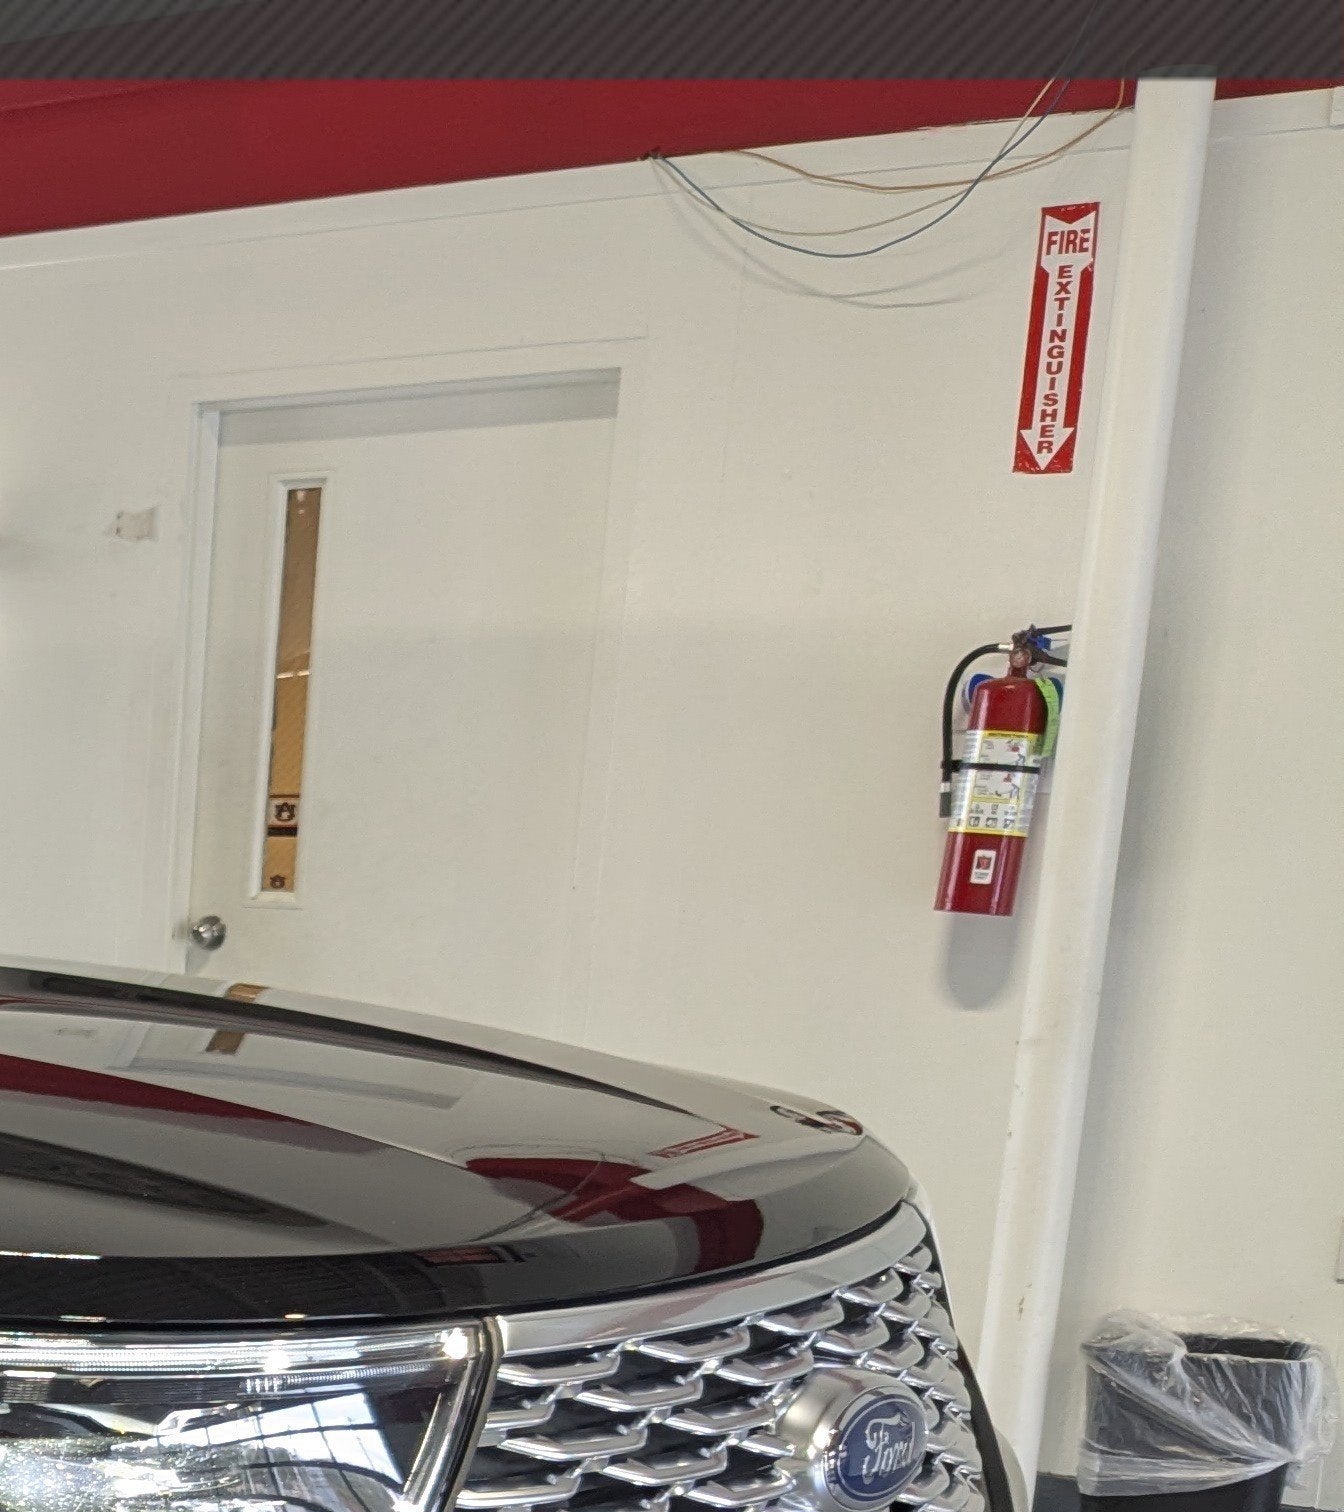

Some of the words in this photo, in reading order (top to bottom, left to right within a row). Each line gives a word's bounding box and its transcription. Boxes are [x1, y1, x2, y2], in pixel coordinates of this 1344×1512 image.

[1045, 228, 1091, 256] FIRE
[1036, 263, 1074, 455] EXTINGUISHER
[861, 1409, 917, 1485] Ford
